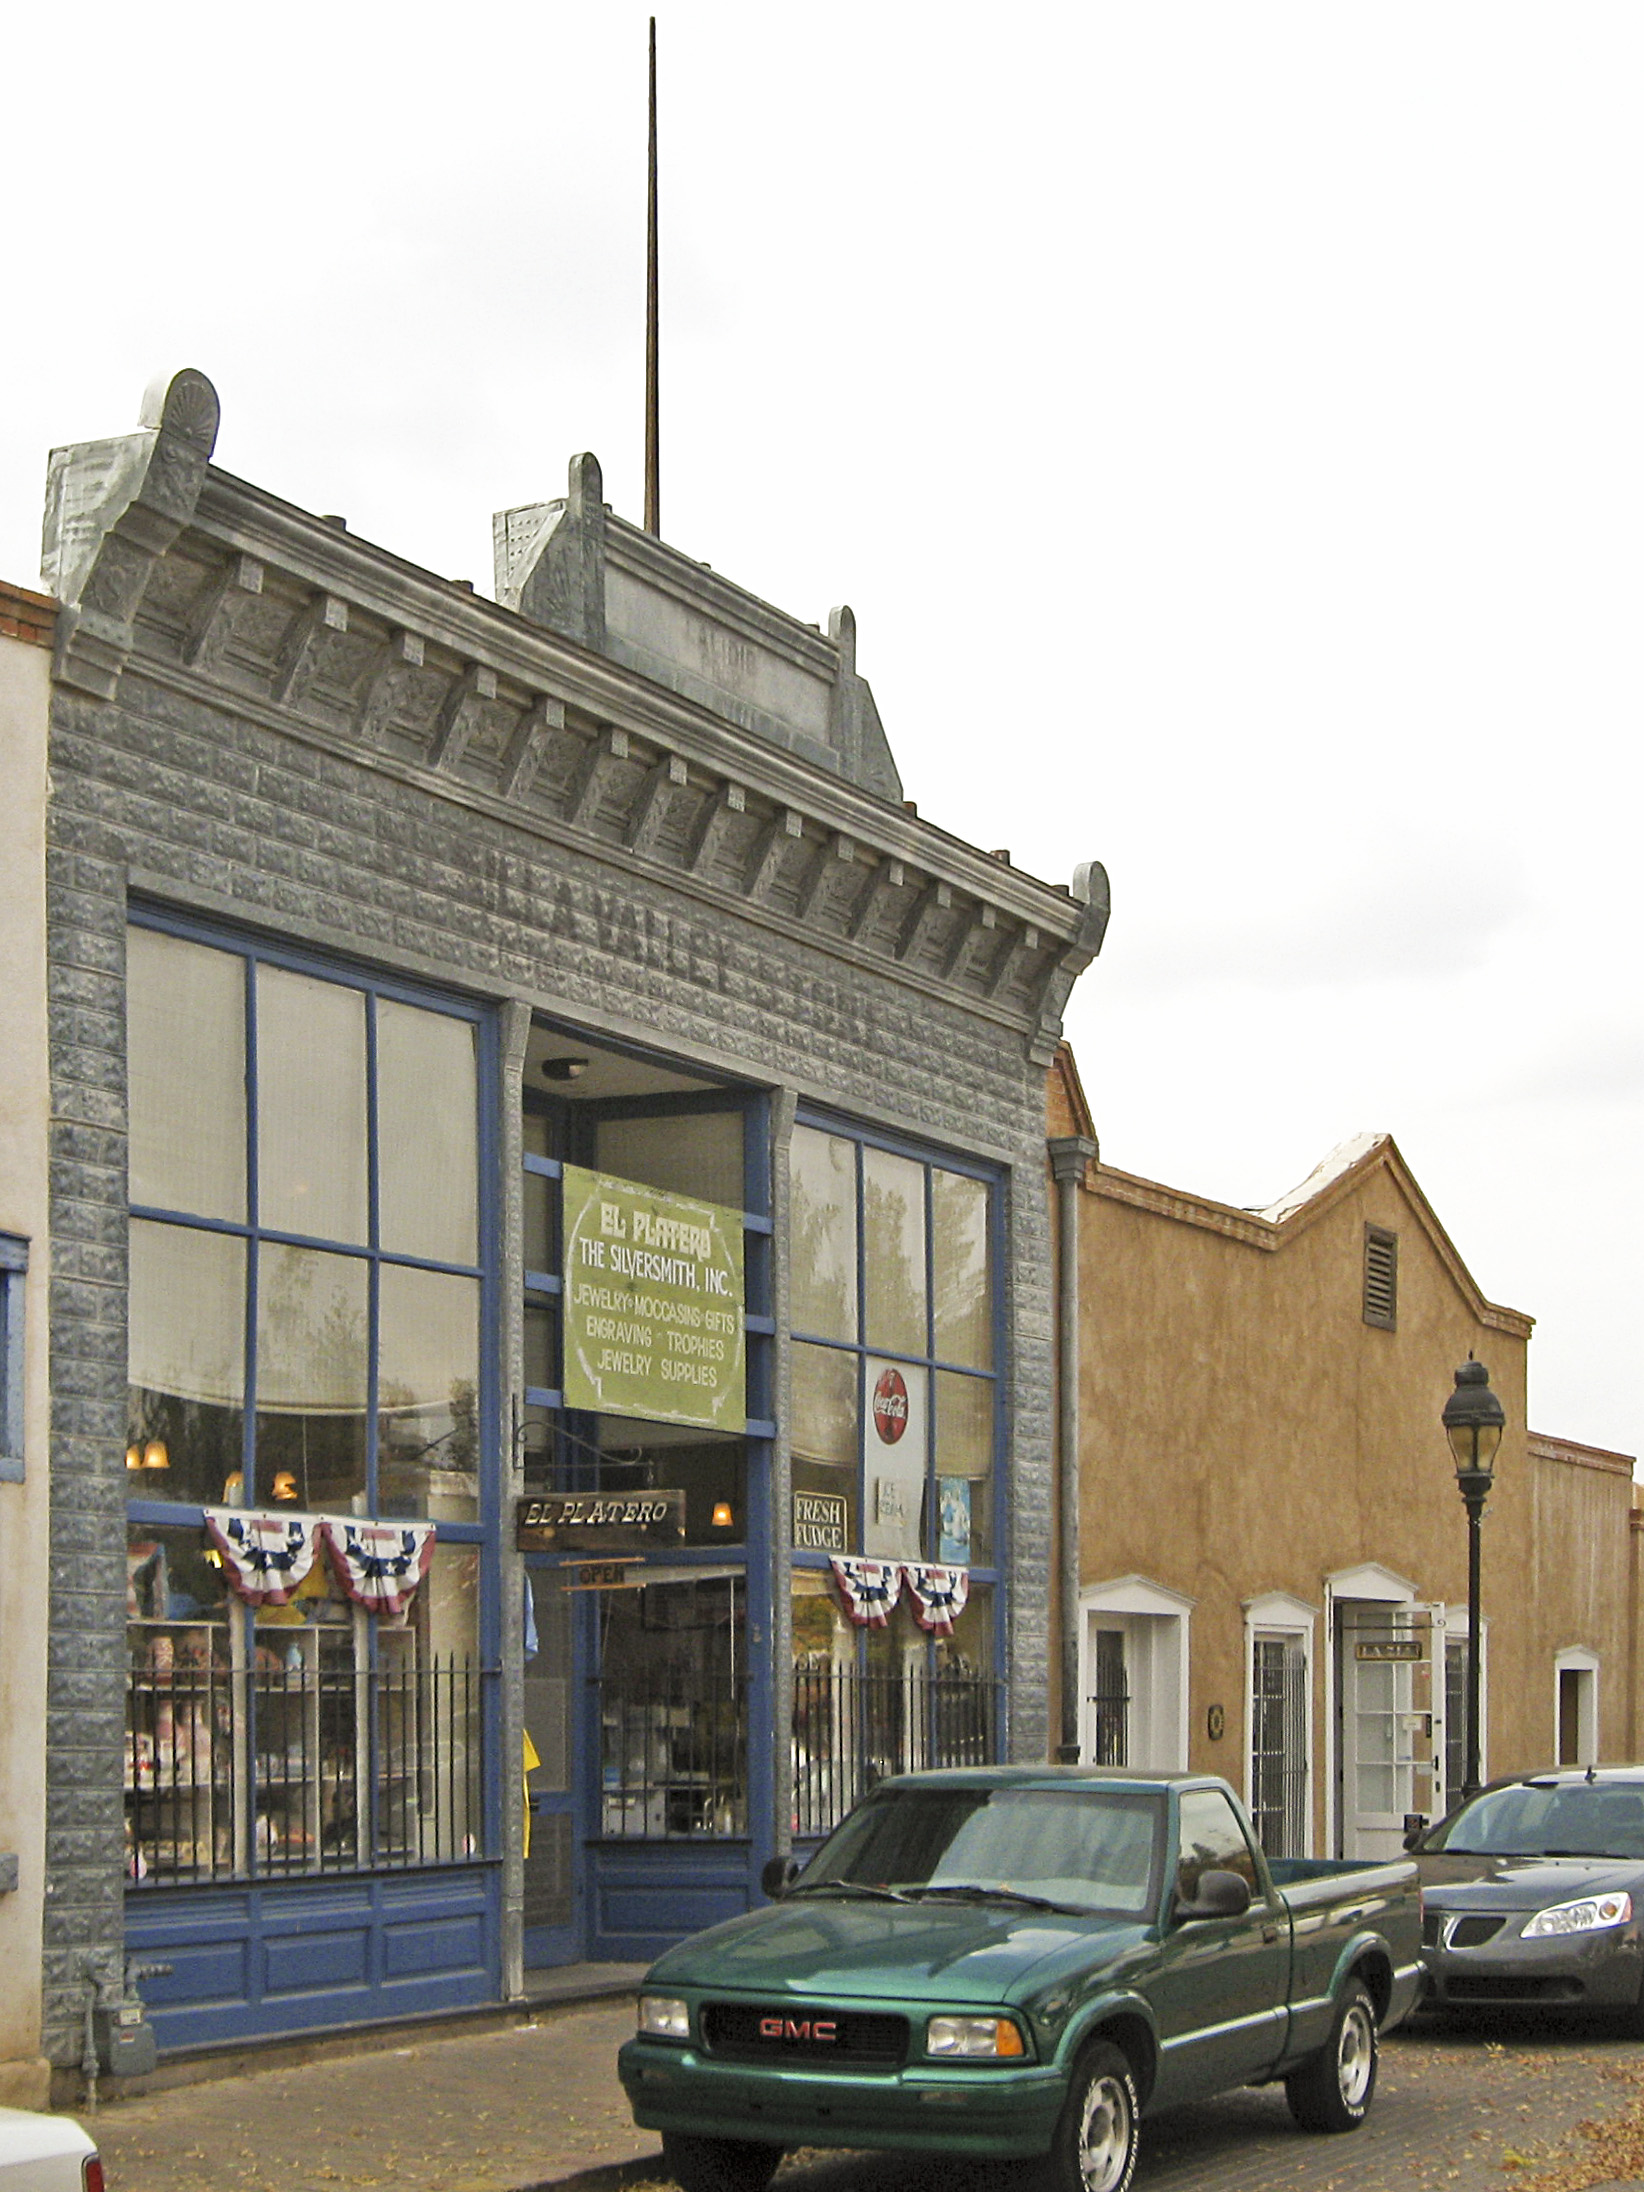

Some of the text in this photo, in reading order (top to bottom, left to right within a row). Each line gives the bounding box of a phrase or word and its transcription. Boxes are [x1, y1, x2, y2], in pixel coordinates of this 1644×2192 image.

[601, 1202, 626, 1239] EL
[579, 1237, 733, 1297] THE SILVERSMITH, INC.
[705, 1310, 735, 1335] GIFTS
[586, 1317, 725, 1361] ENGRAVING TROPHIES
[597, 1348, 717, 1388] JEWELRY SUPPLIES
[525, 1501, 668, 1525] EL PLATERO
[796, 1498, 841, 1523] FRESH
[796, 1526, 842, 1550] FUDGE
[578, 1566, 626, 1585] OPEN
[760, 2018, 837, 2040] GMC
